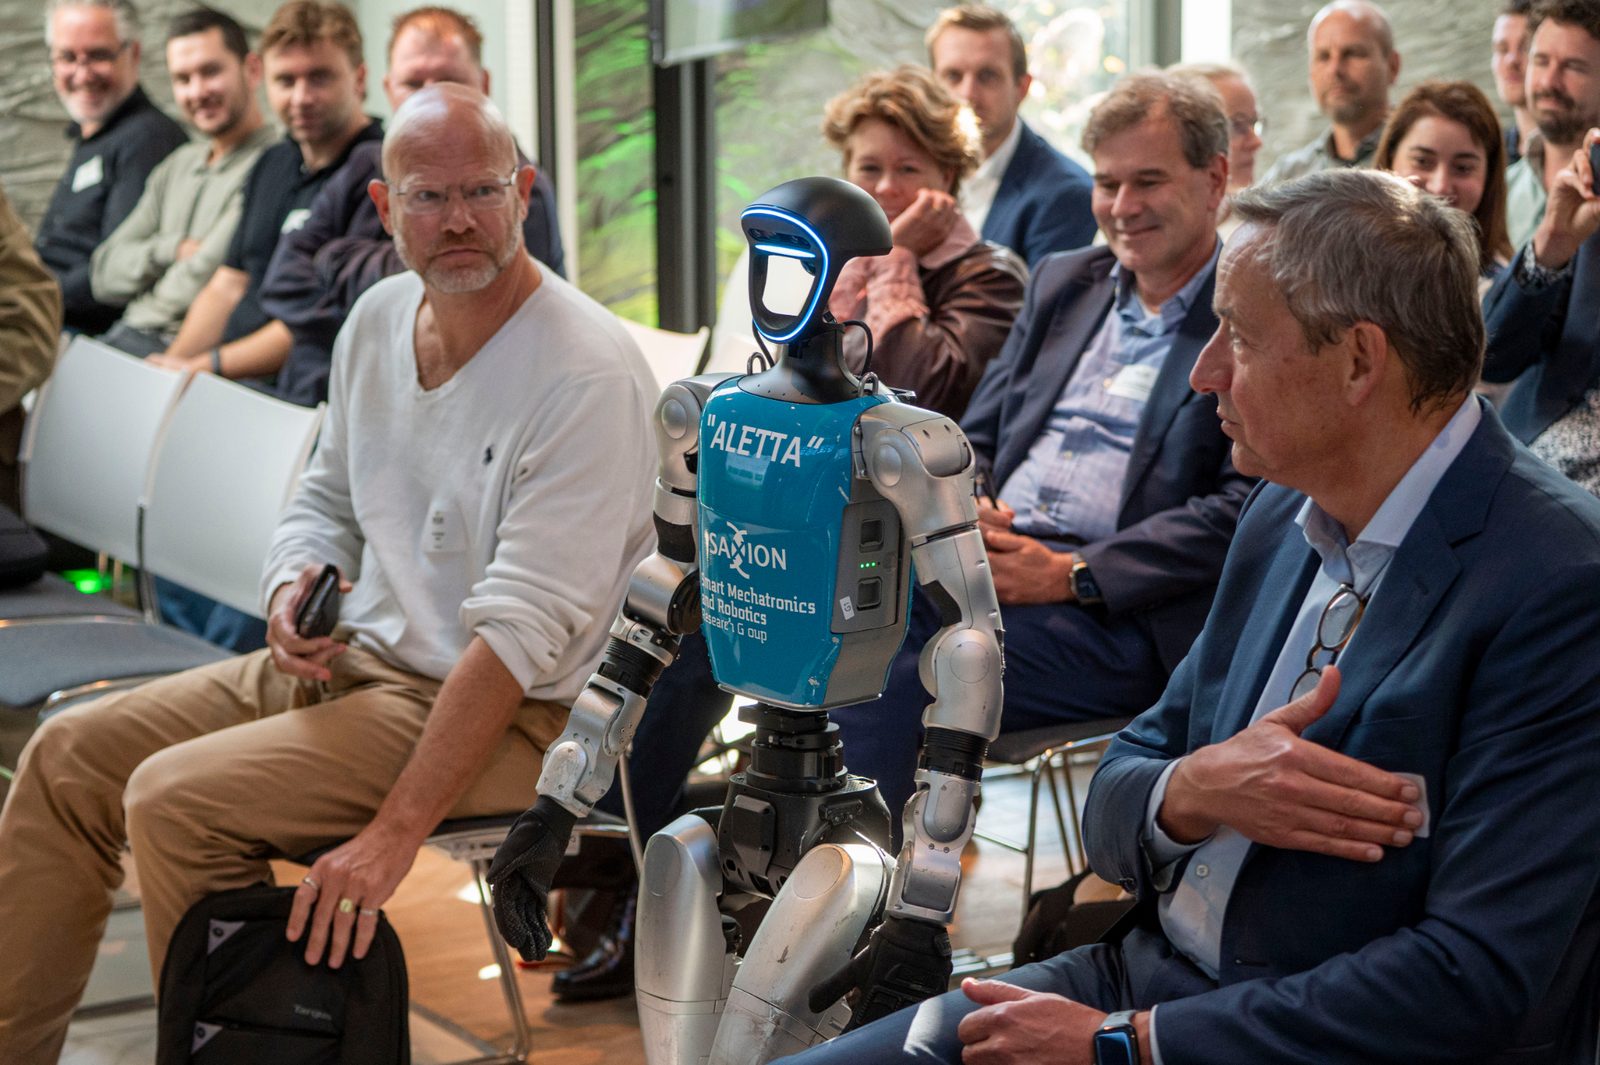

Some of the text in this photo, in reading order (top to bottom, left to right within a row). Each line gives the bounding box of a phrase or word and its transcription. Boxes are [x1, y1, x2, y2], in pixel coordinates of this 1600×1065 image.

[706, 413, 824, 468] "ALETTA"
[709, 521, 787, 579] SAXION
[717, 598, 767, 626] Robotics
[727, 582, 816, 614] Mechatronics
[737, 622, 767, 644] Goup
